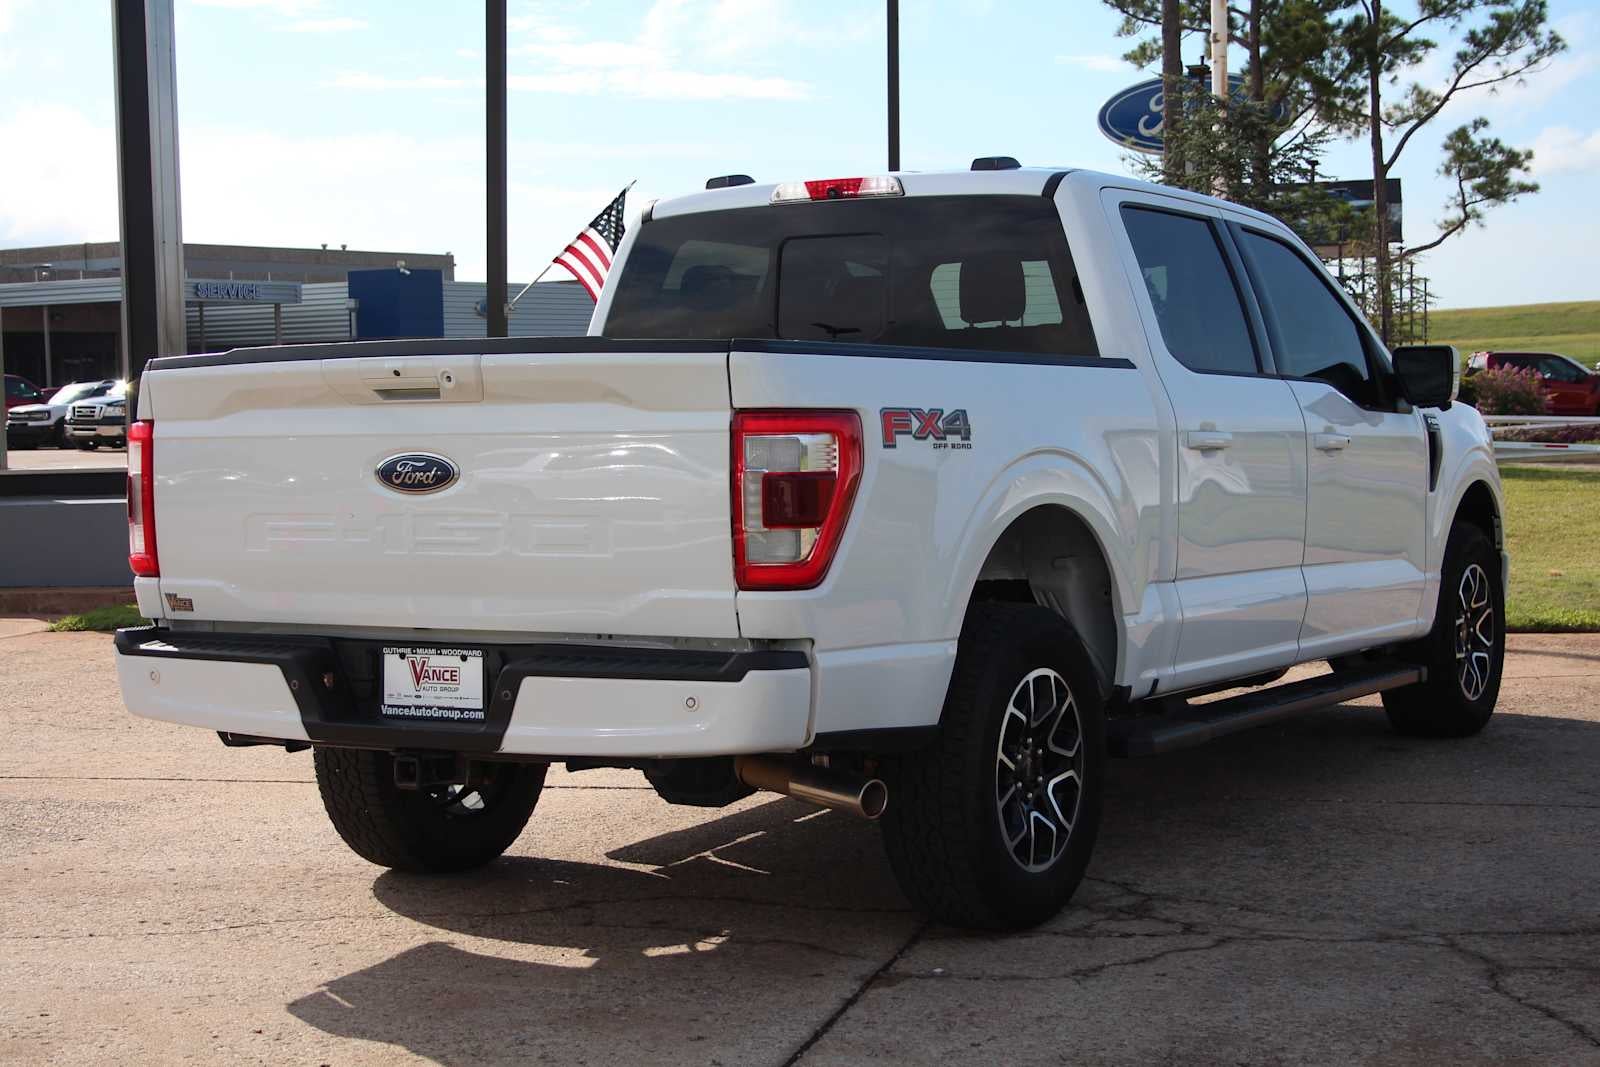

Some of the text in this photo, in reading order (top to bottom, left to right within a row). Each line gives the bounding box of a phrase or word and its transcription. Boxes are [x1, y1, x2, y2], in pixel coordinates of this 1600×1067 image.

[196, 282, 262, 299] SERVICE
[880, 407, 971, 449] FX4
[392, 460, 437, 484] Ford
[383, 647, 412, 655] GUTHRIE
[441, 649, 482, 657] WOODWARD
[407, 657, 460, 688] VANCE
[381, 705, 484, 719] VanceAutoGroup.com
